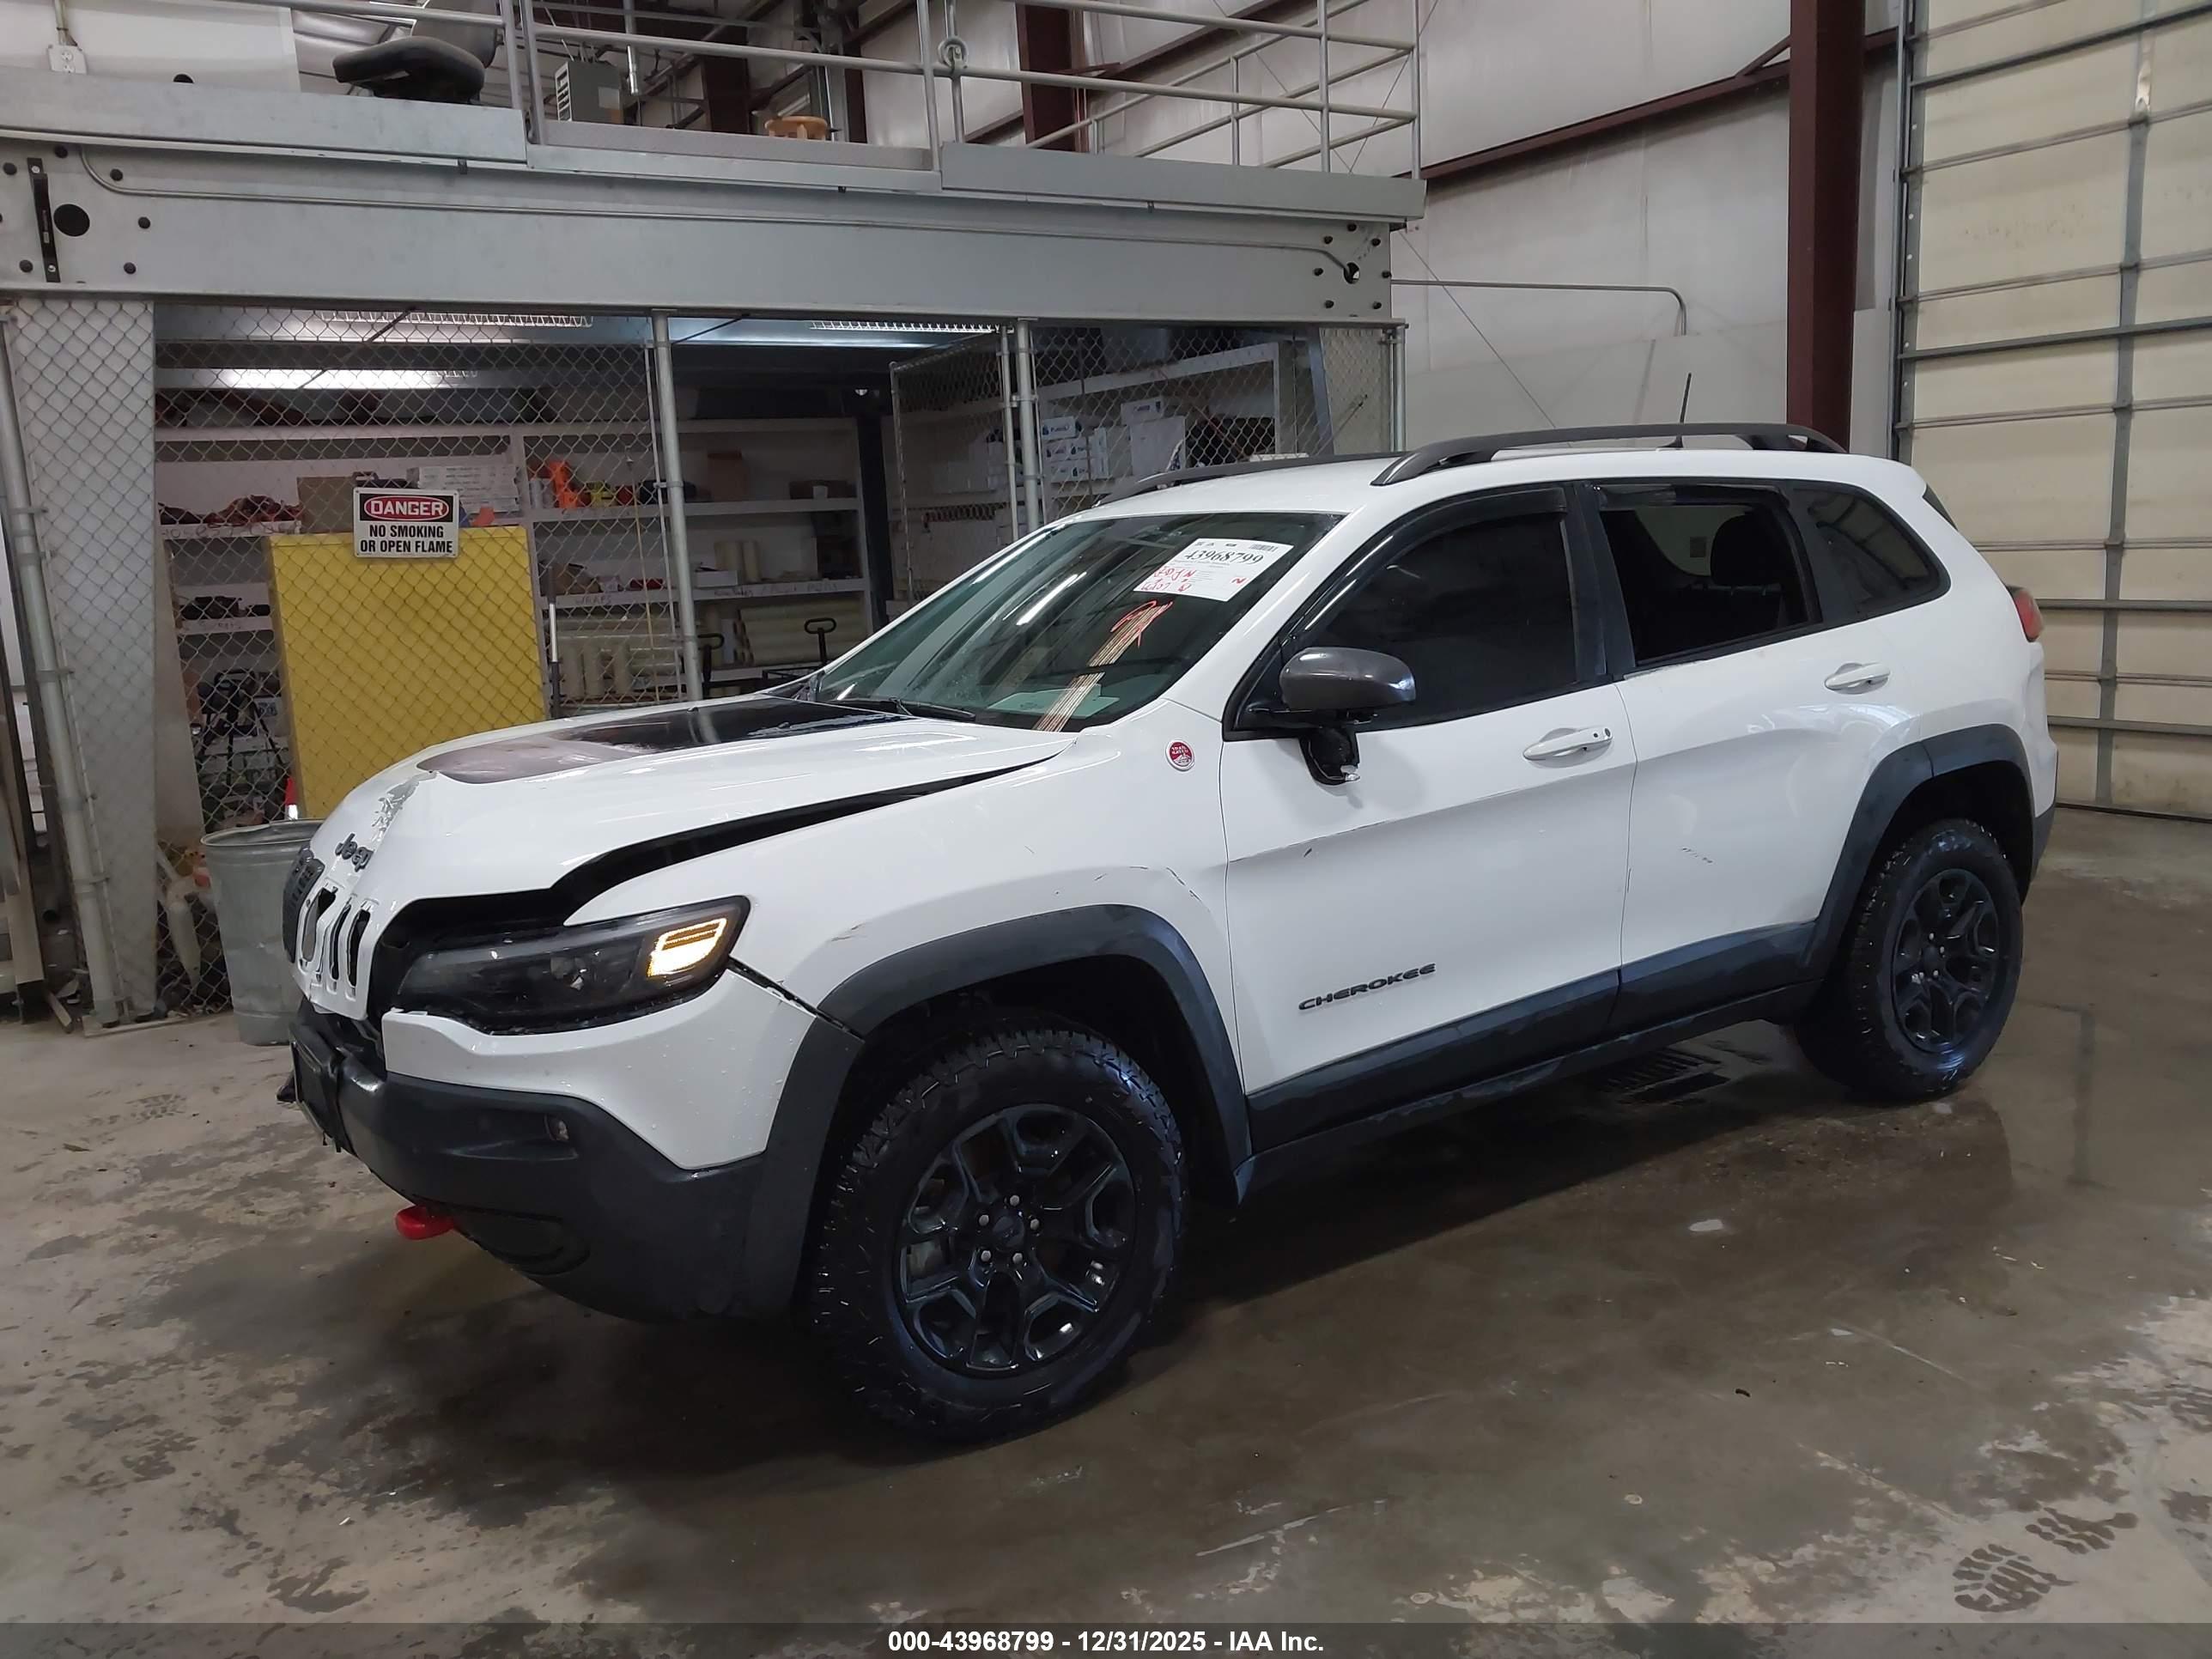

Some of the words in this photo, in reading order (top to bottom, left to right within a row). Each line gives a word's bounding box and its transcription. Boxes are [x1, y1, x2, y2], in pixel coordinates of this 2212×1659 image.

[370, 501, 443, 516] DANGER
[369, 525, 386, 538] NO
[390, 525, 444, 538] SMOKING
[360, 540, 376, 552] OR
[380, 540, 410, 552] OPEN
[415, 540, 453, 553] FLAME
[1184, 550, 1265, 565] 43968799
[335, 833, 374, 872] Jeep
[1298, 963, 1436, 1011] CHEROKEE
